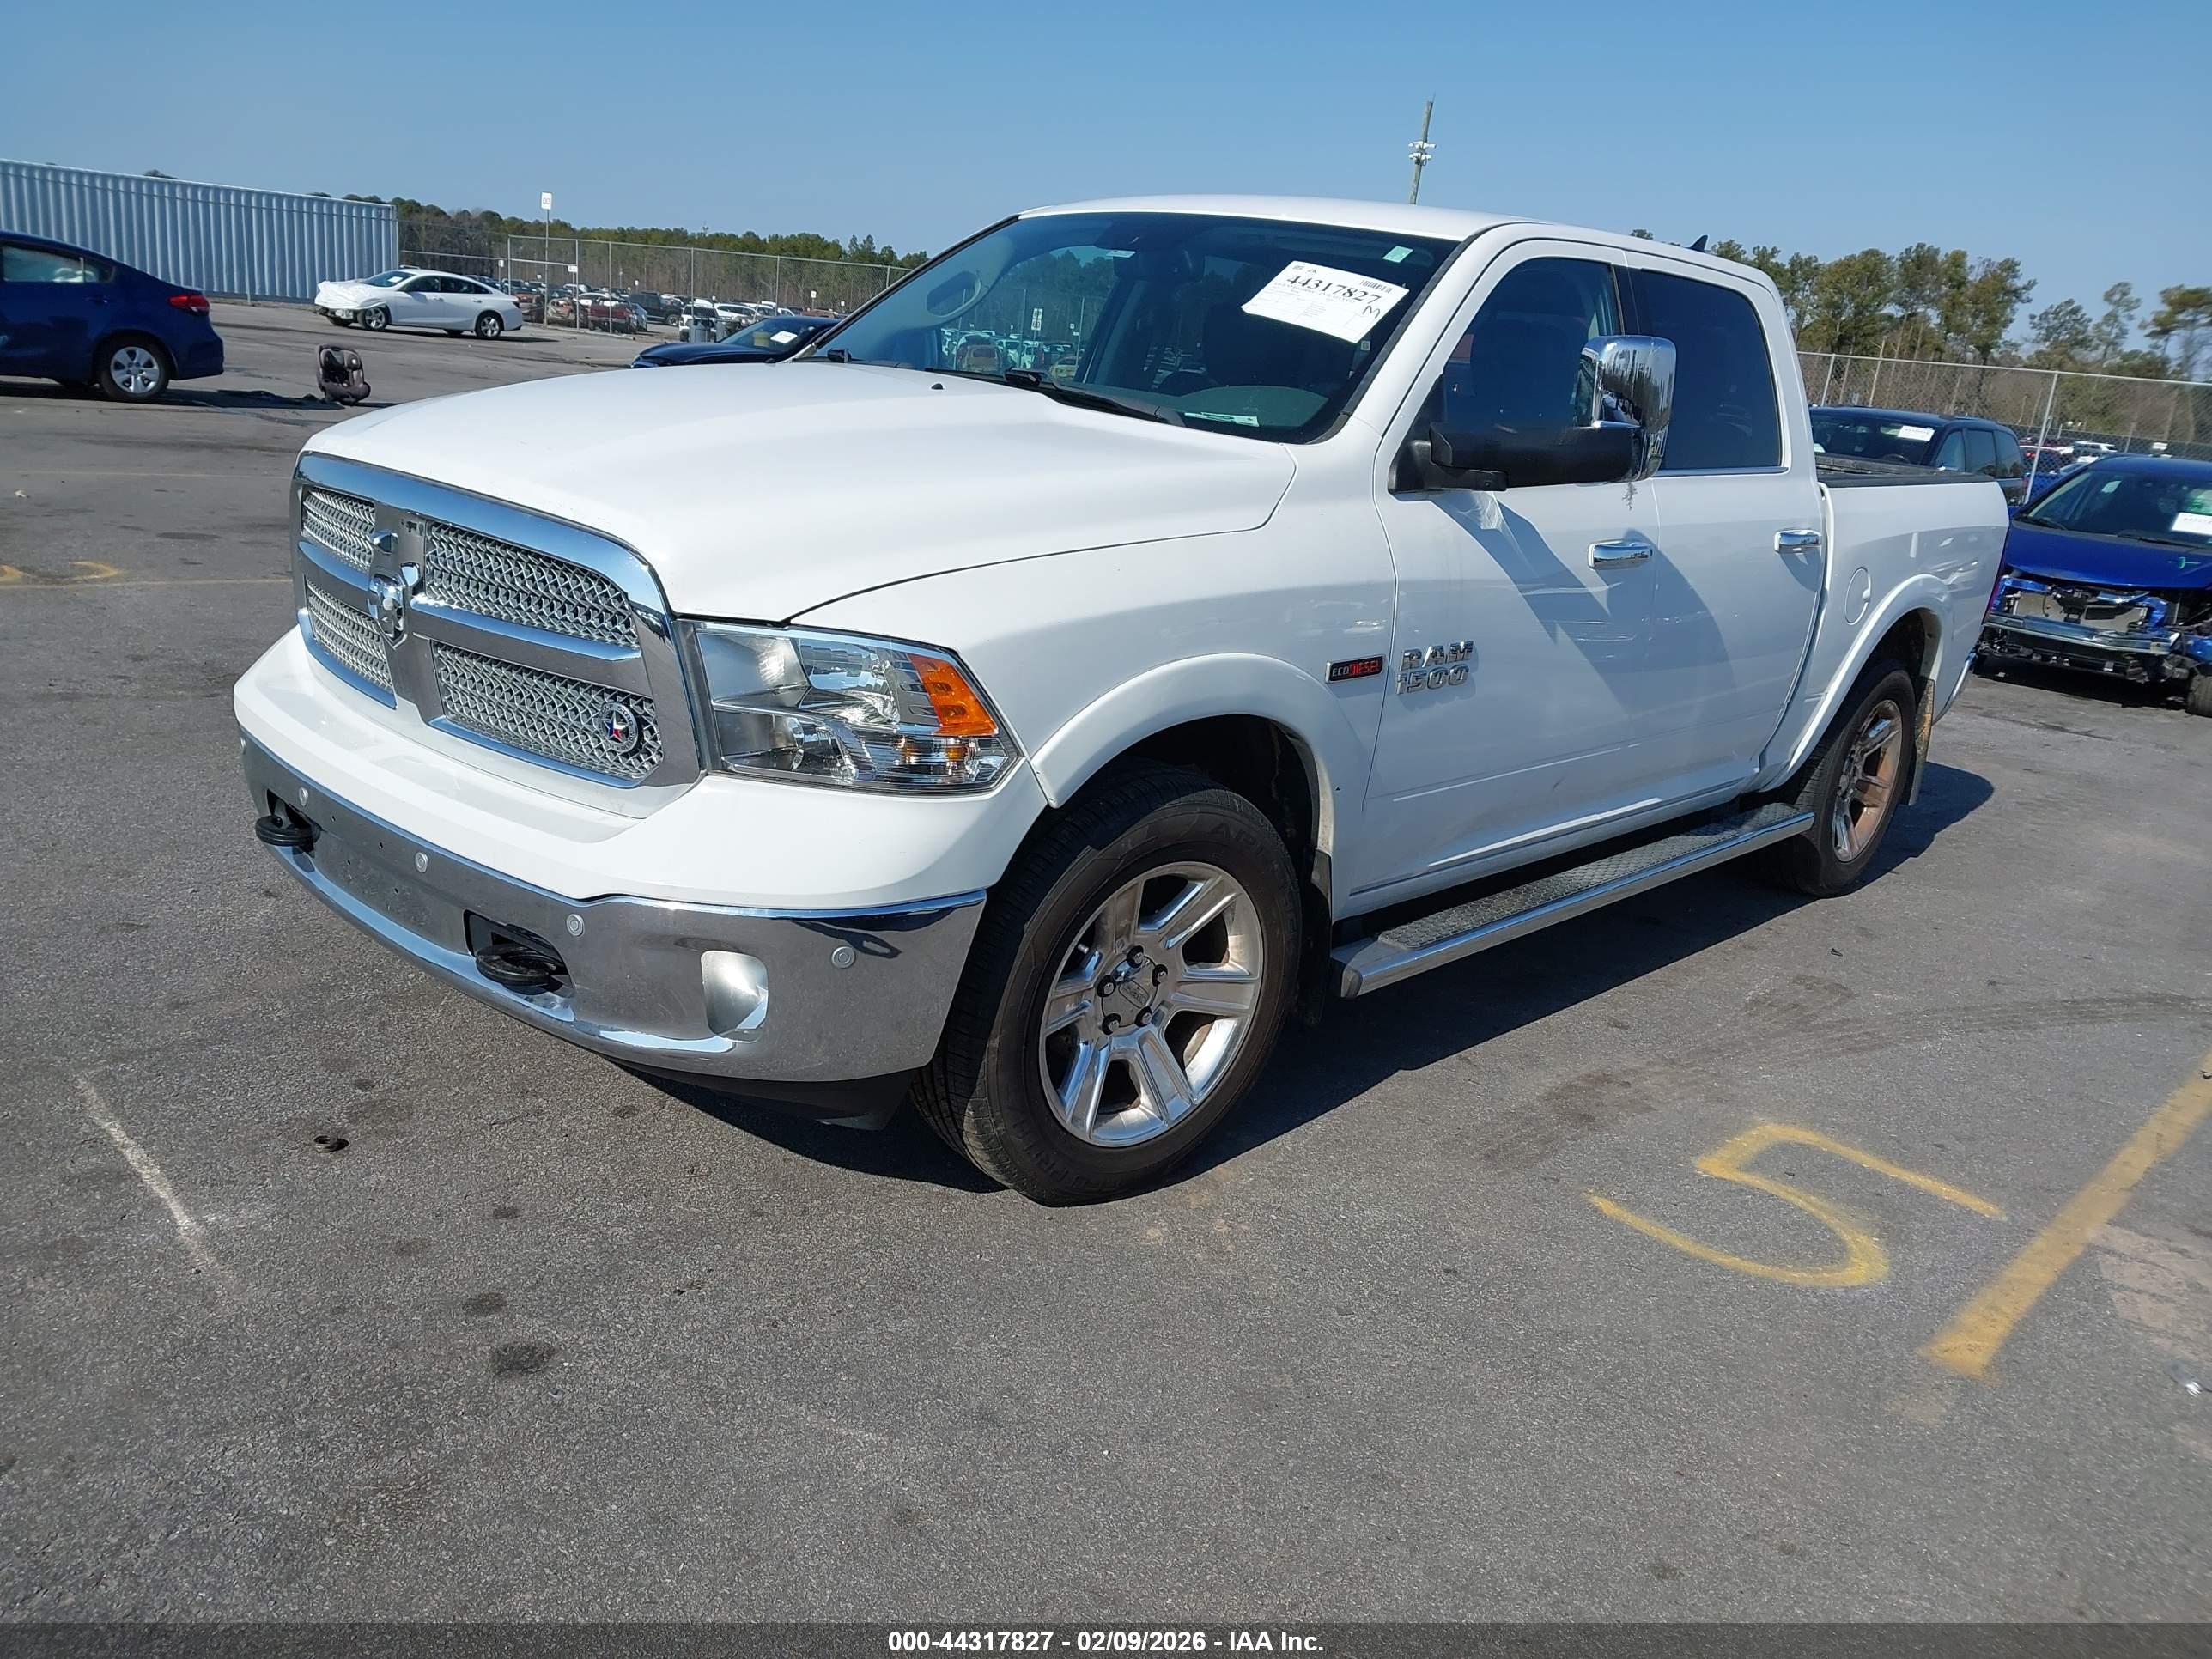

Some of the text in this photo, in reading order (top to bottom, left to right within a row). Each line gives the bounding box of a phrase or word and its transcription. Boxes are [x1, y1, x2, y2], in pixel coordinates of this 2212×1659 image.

[1287, 275, 1382, 304] 44317827
[1400, 640, 1474, 672] RAM
[1395, 664, 1470, 695] 1500
